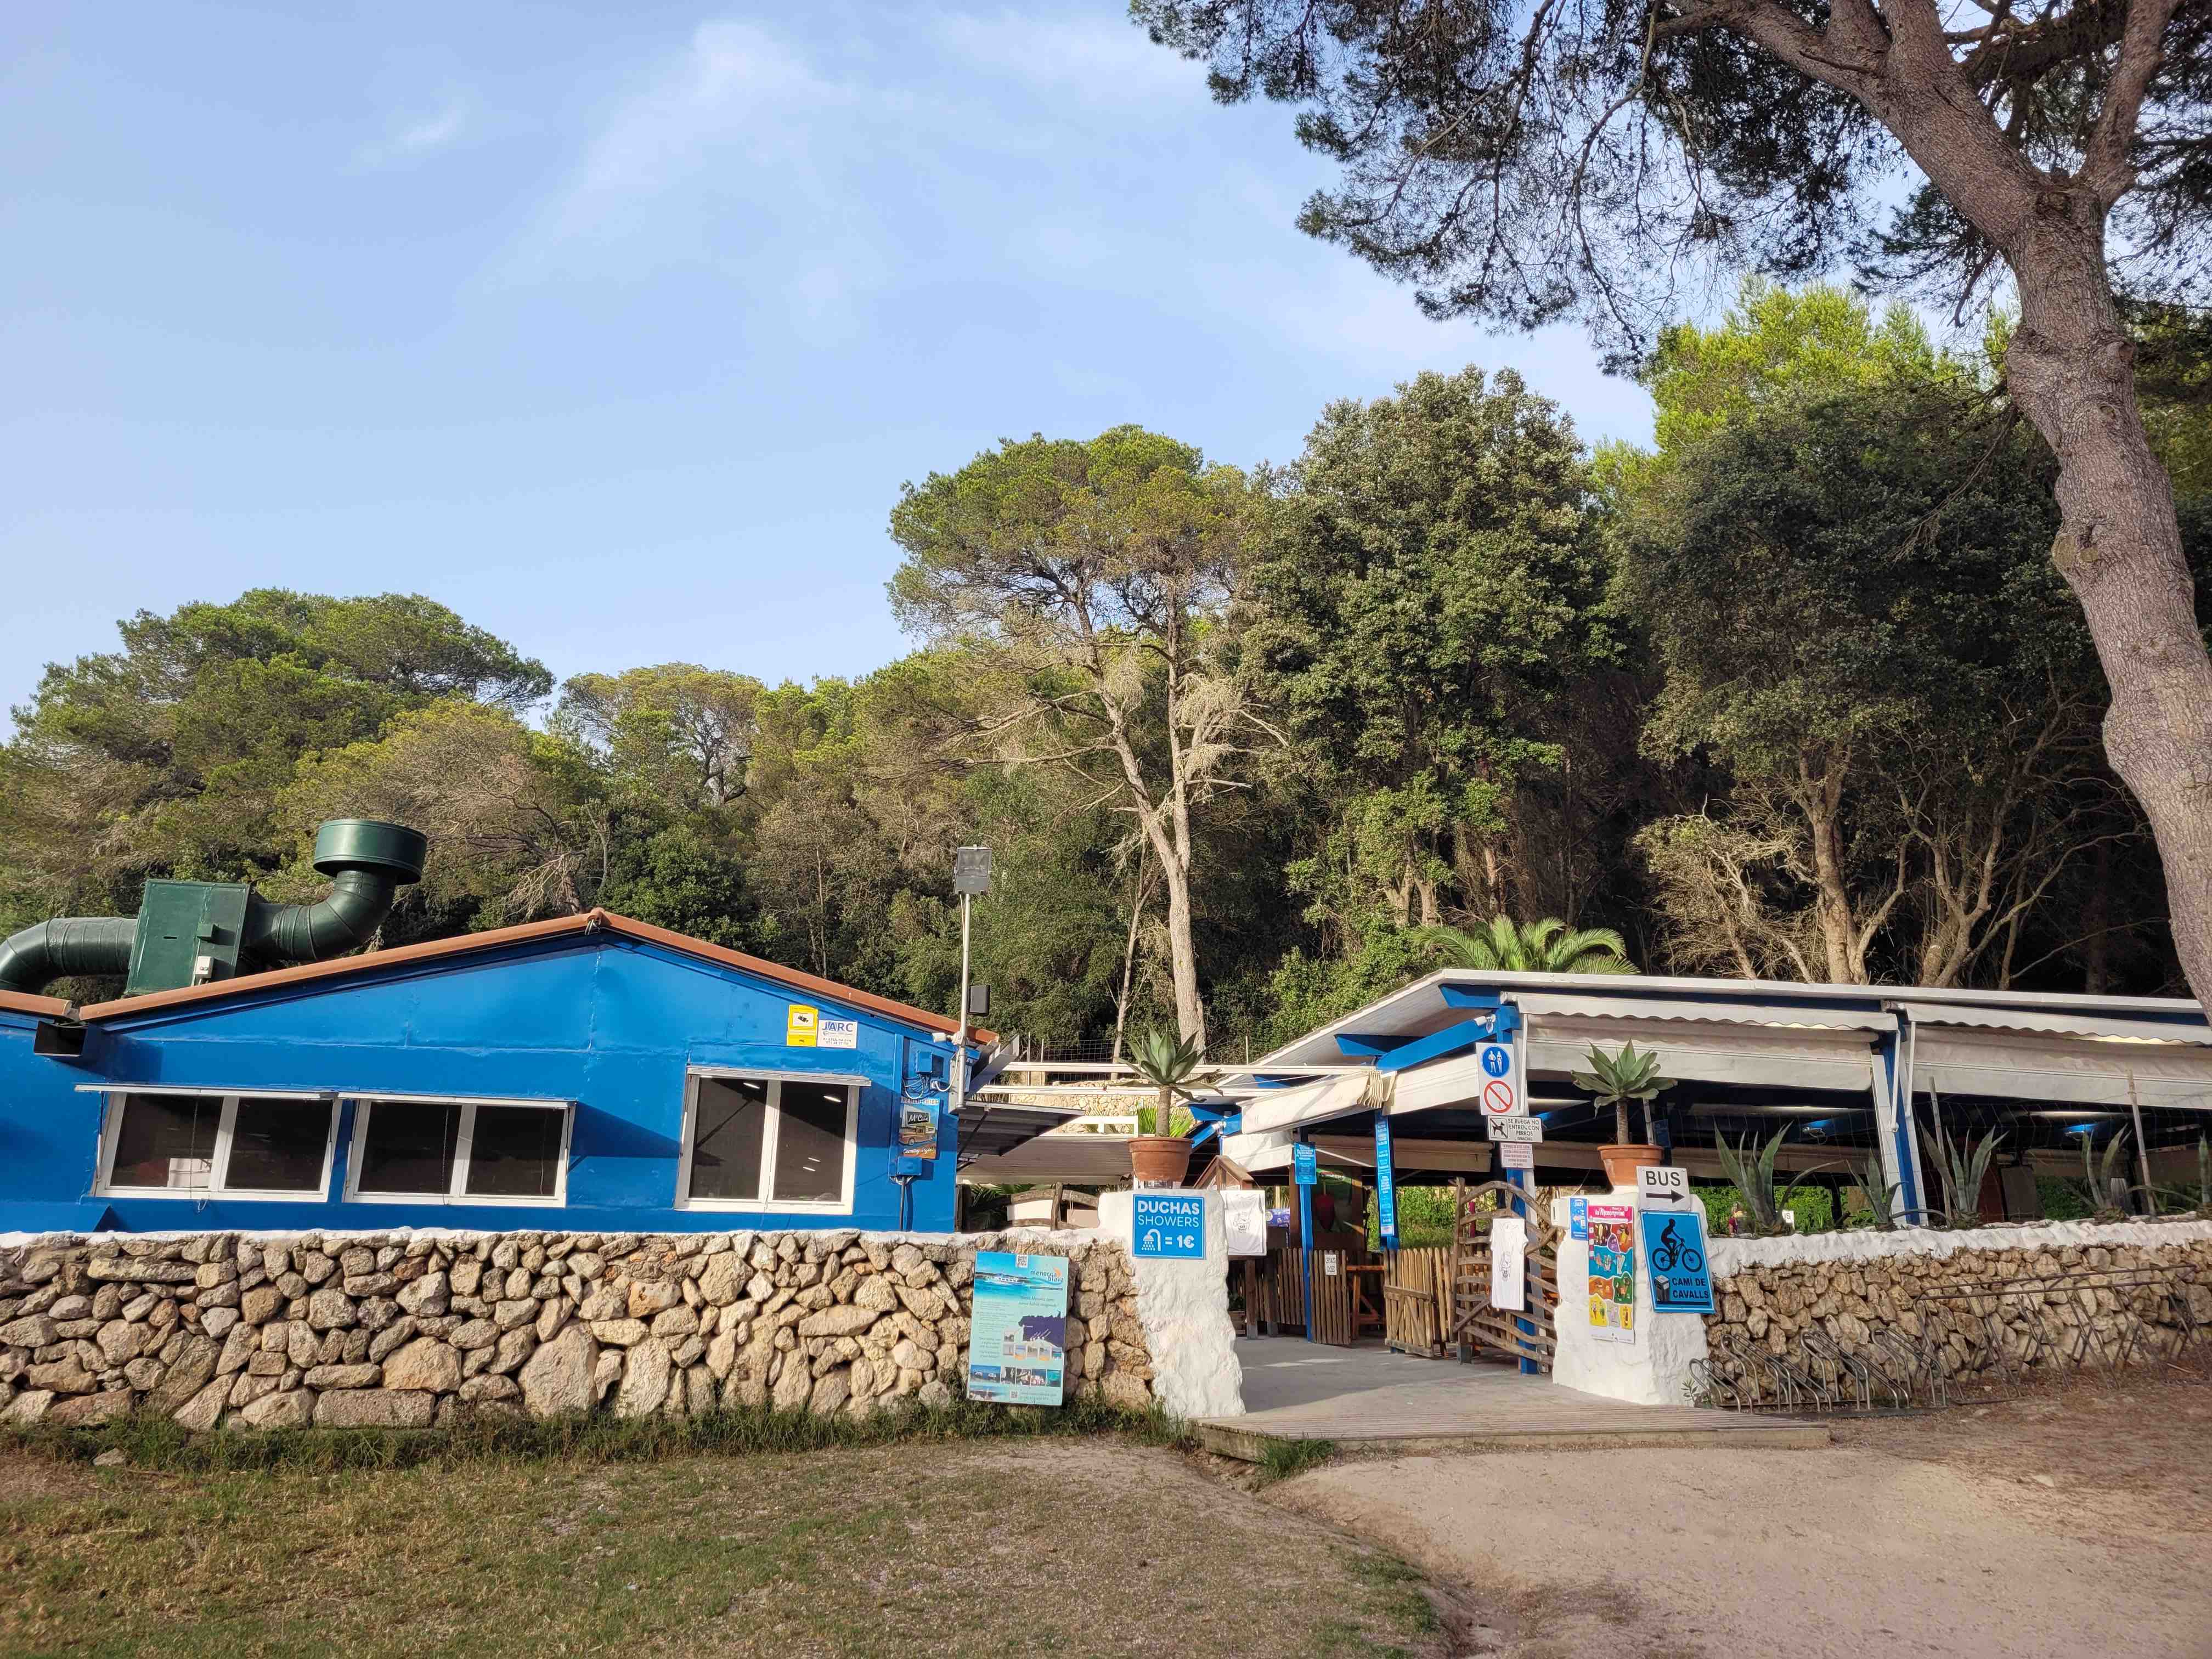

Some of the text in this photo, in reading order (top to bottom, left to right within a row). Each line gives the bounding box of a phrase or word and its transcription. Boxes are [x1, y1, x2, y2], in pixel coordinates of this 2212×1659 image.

[822, 1021, 853, 1032] JARC
[1646, 1171, 1681, 1186] BUS
[1137, 1200, 1200, 1215] DUCHAS
[1138, 1215, 1199, 1227] SHOWERS
[1177, 1234, 1195, 1249] 1€
[1695, 1278, 1707, 1286] DE
[1673, 1290, 1709, 1299] CAVALLS
